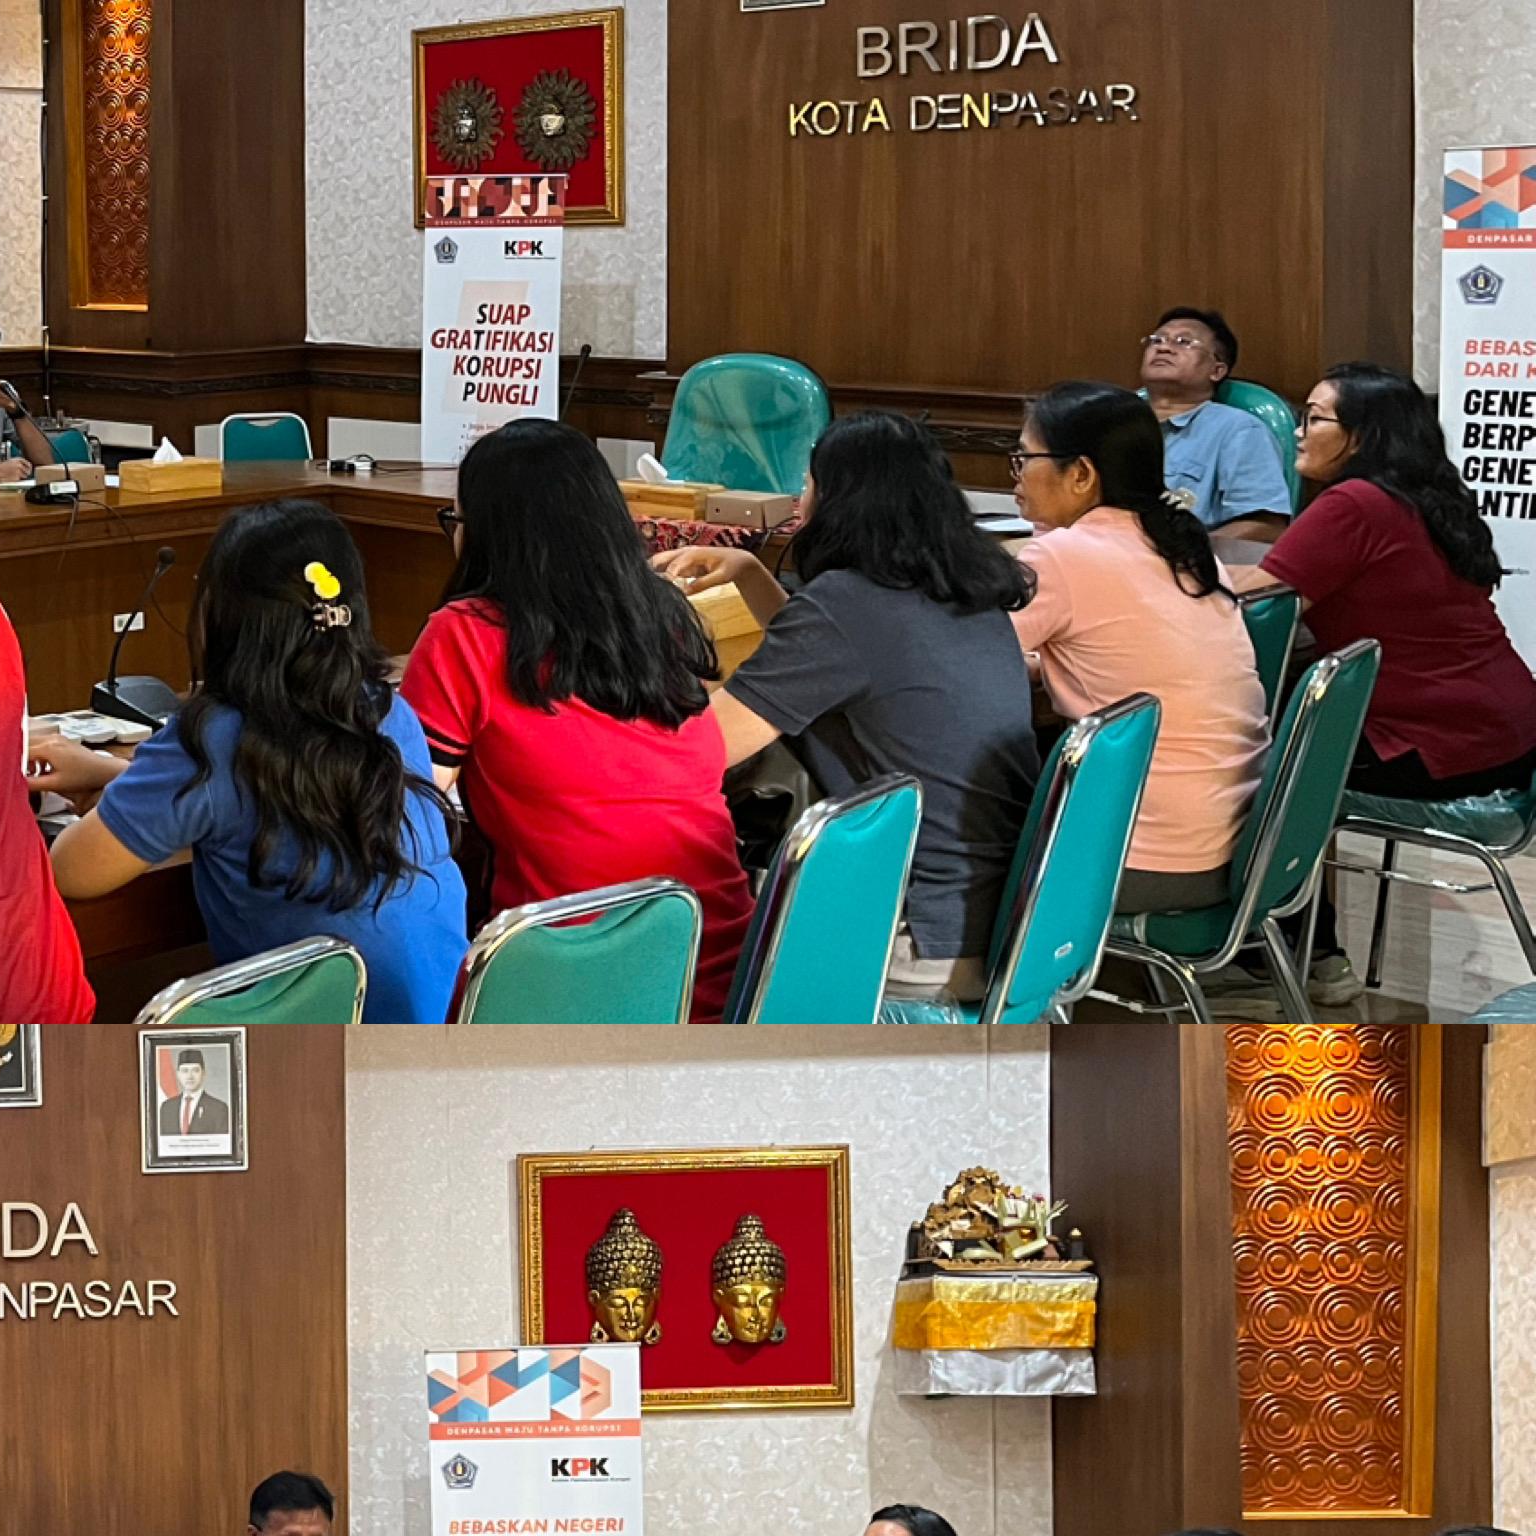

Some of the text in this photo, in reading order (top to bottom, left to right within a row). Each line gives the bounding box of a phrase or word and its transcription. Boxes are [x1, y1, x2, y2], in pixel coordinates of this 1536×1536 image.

[856, 12, 1059, 77] BRIDA
[789, 84, 1139, 136] KOTA DENPASAR
[504, 240, 543, 255] KPK
[1467, 234, 1534, 243] DENPASAR
[476, 303, 531, 325] SUAP
[431, 328, 554, 353] GRATIFIKASI
[453, 354, 542, 379] KORUPSI
[1465, 362, 1519, 378] DARI
[463, 382, 539, 406] PUNGLI
[447, 1427, 501, 1435] DENPASAR
[505, 1426, 534, 1434] MAJU
[538, 1425, 571, 1433] TANPA
[551, 1458, 609, 1477] KPK
[449, 1517, 624, 1534] BEBASKAN NEGERI
